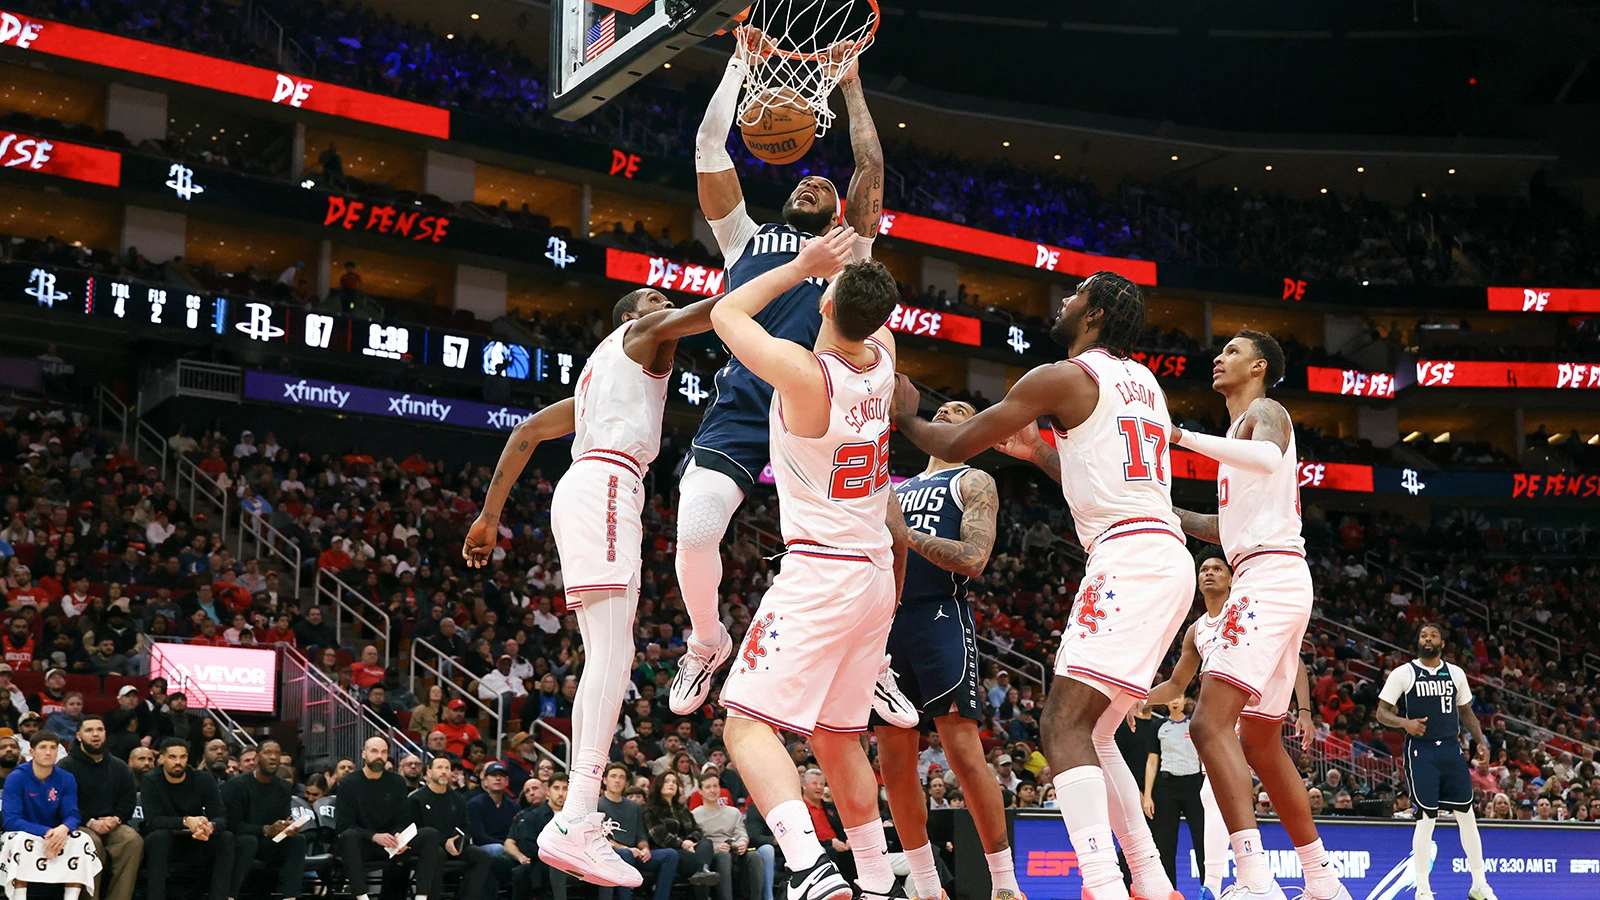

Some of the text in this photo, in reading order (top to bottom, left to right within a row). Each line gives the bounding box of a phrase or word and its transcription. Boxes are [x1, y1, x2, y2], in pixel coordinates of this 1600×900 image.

[0, 12, 43, 49] DE
[272, 74, 313, 108] DE
[748, 138, 798, 154] Wilson
[610, 149, 642, 179] DE
[879, 212, 896, 236] E
[752, 232, 808, 257] MA
[1035, 244, 1060, 271] DE
[1283, 277, 1308, 301] DE
[1522, 289, 1550, 312] DE
[151, 303, 162, 324] 2
[305, 313, 334, 349] 67
[442, 335, 469, 369] 57
[283, 380, 350, 408] xfinity
[1115, 380, 1155, 411] EASON
[388, 394, 451, 421] xfinity
[487, 407, 533, 428] xfin
[1117, 416, 1167, 486] 17
[1297, 462, 1325, 486] SE
[606, 475, 618, 562] ROCKETS
[194, 665, 266, 684] VEVOR
[1415, 680, 1453, 697] MAVS
[1441, 696, 1452, 713] 13
[319, 805, 336, 818] GET
[1452, 858, 1557, 873] SUAY 3:30 AM ET
[1570, 859, 1600, 873] ESPN
